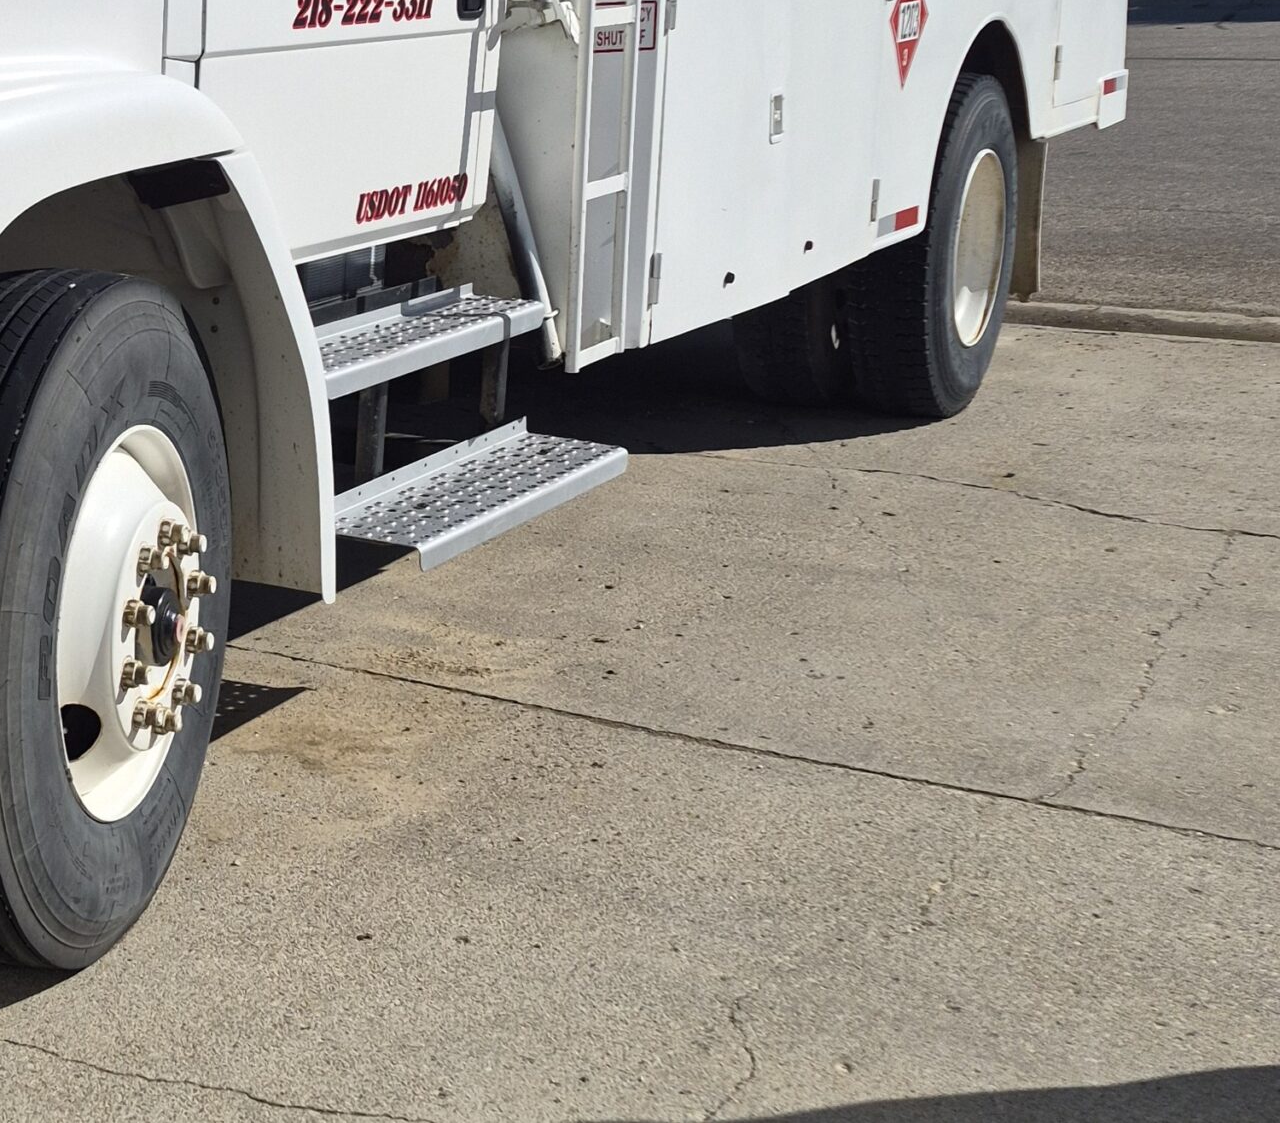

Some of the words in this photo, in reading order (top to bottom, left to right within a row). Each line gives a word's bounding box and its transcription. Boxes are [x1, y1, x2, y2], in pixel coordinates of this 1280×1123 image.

[596, 30, 624, 46] SHUT
[900, 2, 920, 40] 1203
[355, 184, 412, 224] USDOT
[413, 172, 469, 211] 1161050
